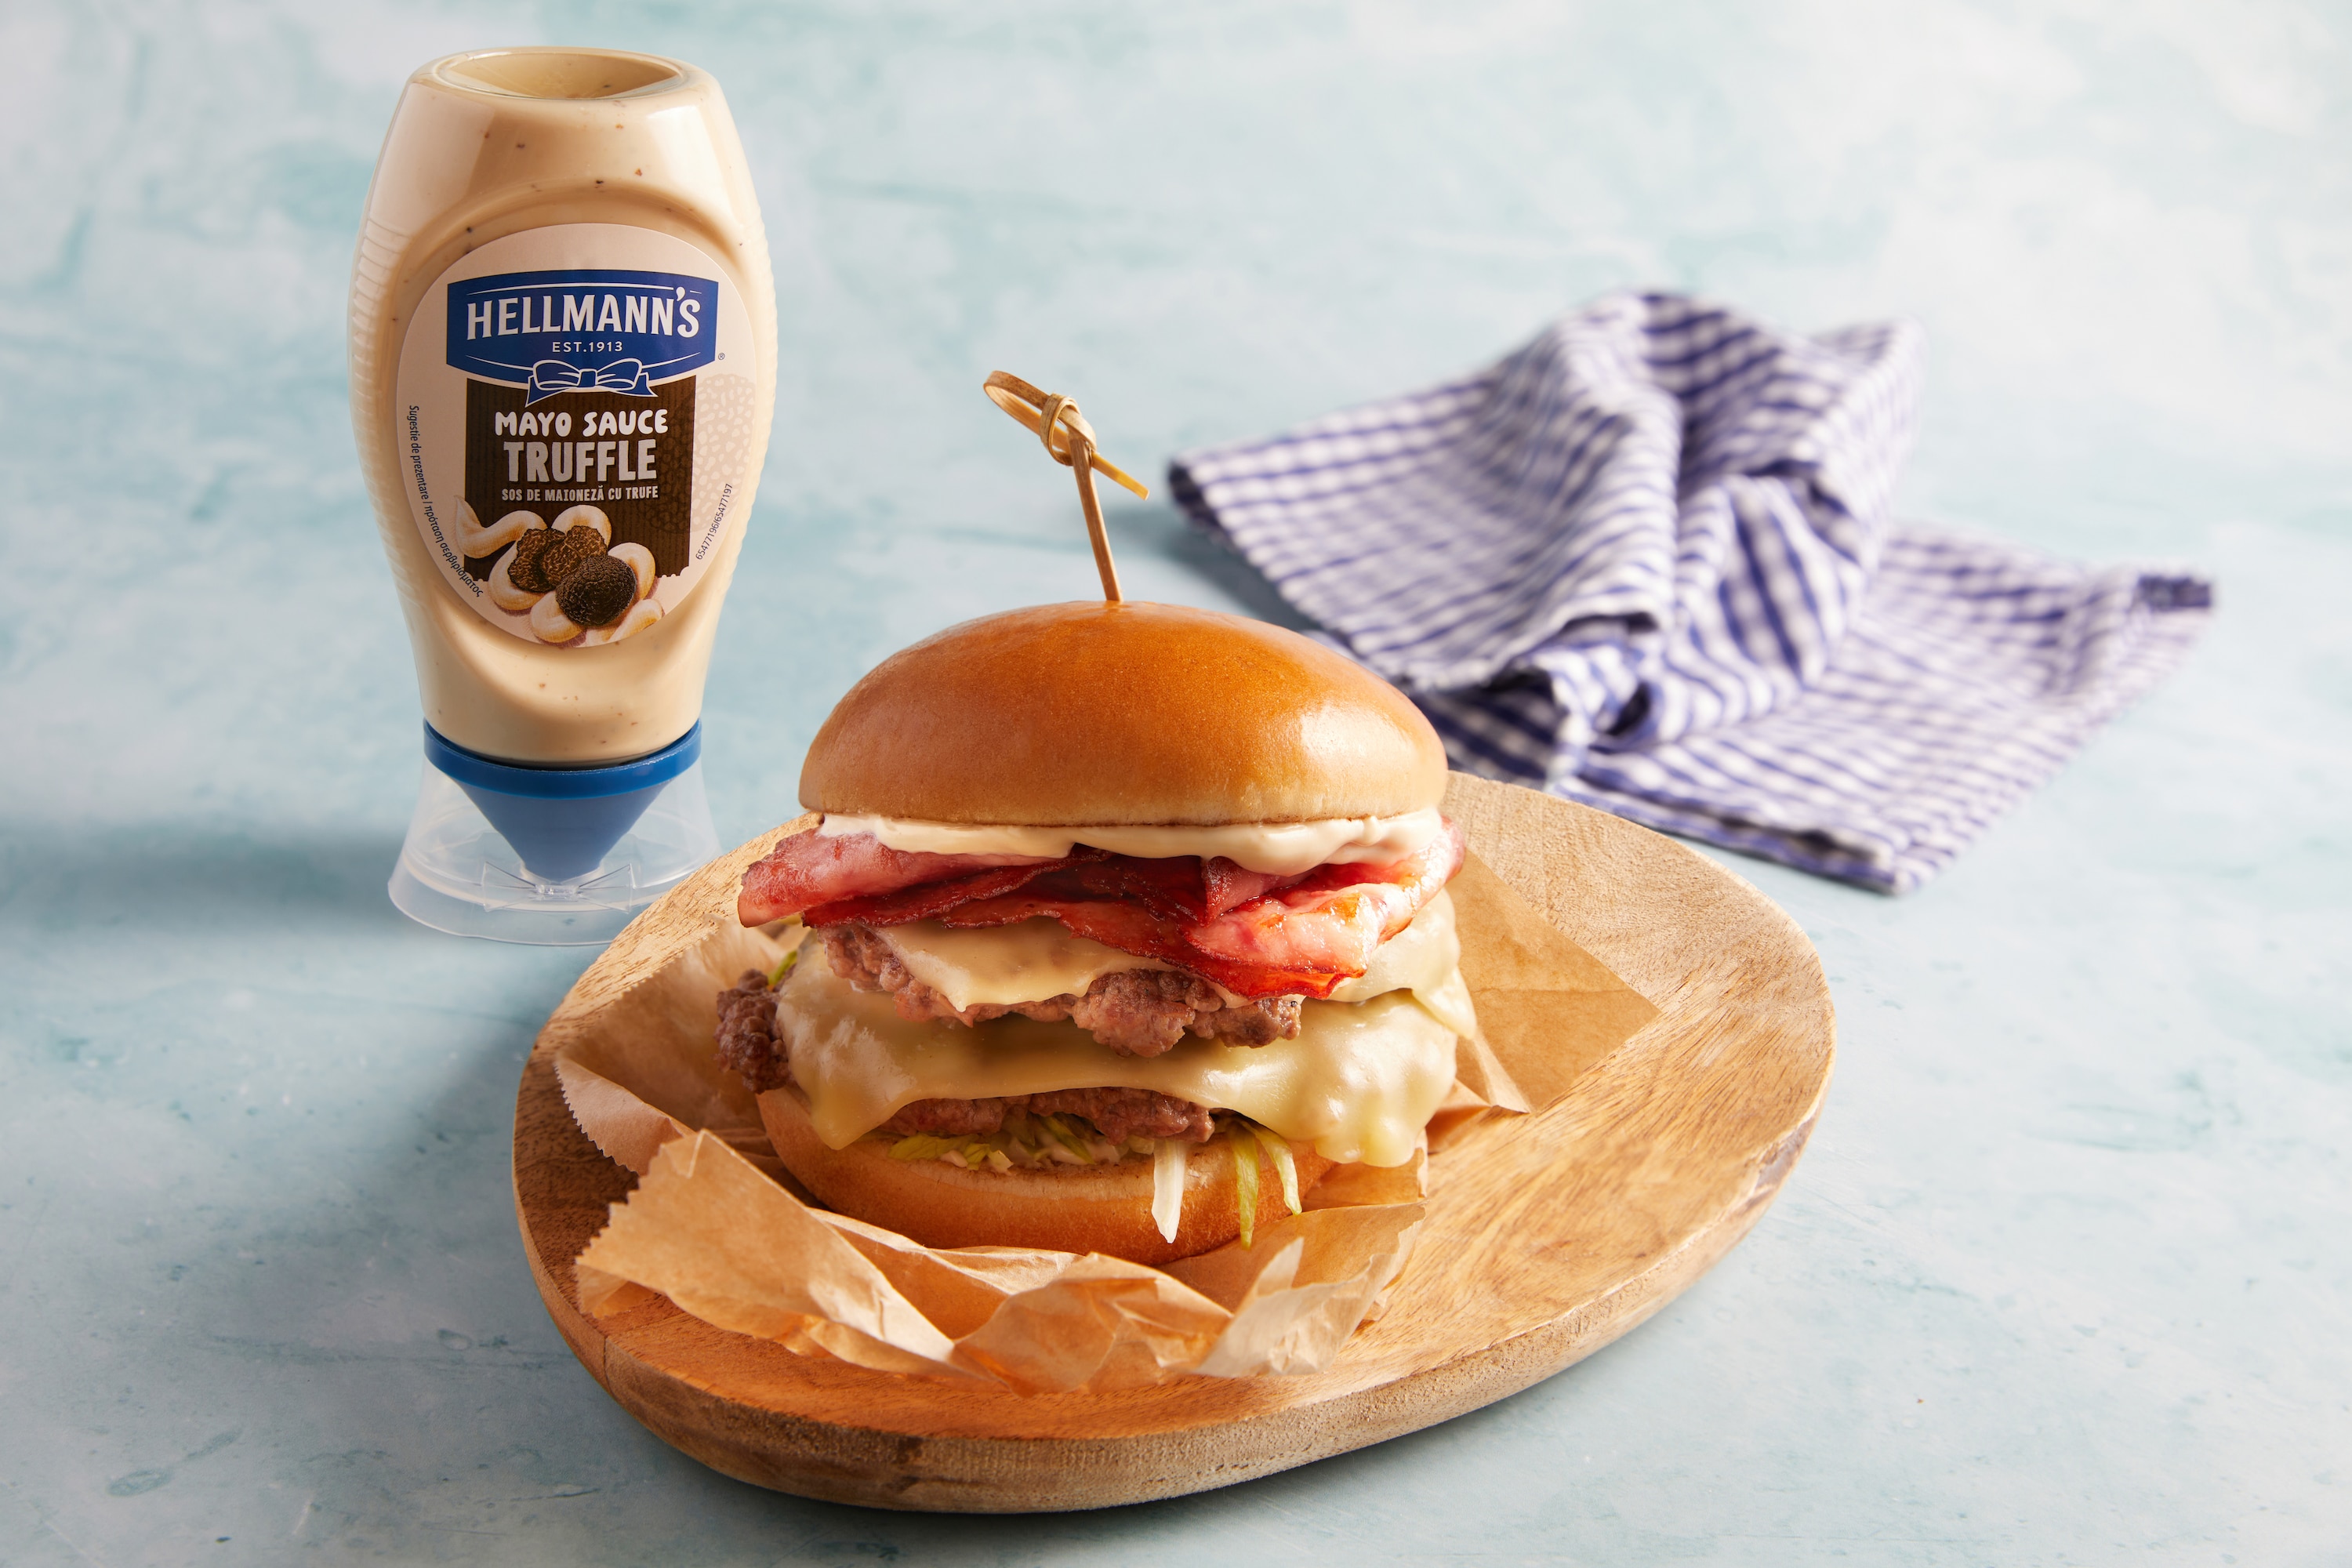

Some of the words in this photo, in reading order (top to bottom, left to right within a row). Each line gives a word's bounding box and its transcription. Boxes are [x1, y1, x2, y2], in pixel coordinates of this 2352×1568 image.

[466, 286, 701, 340] HELLMANN'S
[552, 341, 623, 353] EST.1913
[407, 405, 420, 441] Sugestie
[495, 411, 572, 437] MAYO
[583, 408, 668, 437] SAUCE
[411, 442, 422, 454] de
[503, 438, 657, 483] TRUFFLE
[410, 456, 429, 499] prezentare
[502, 488, 523, 502] SOS
[526, 488, 541, 502] DE
[545, 485, 604, 502] MAIONEZĂ
[608, 486, 622, 500] CU
[626, 485, 659, 499] TRUFE
[424, 506, 444, 543] πρόταση
[695, 483, 733, 560] 65477196/65477197
